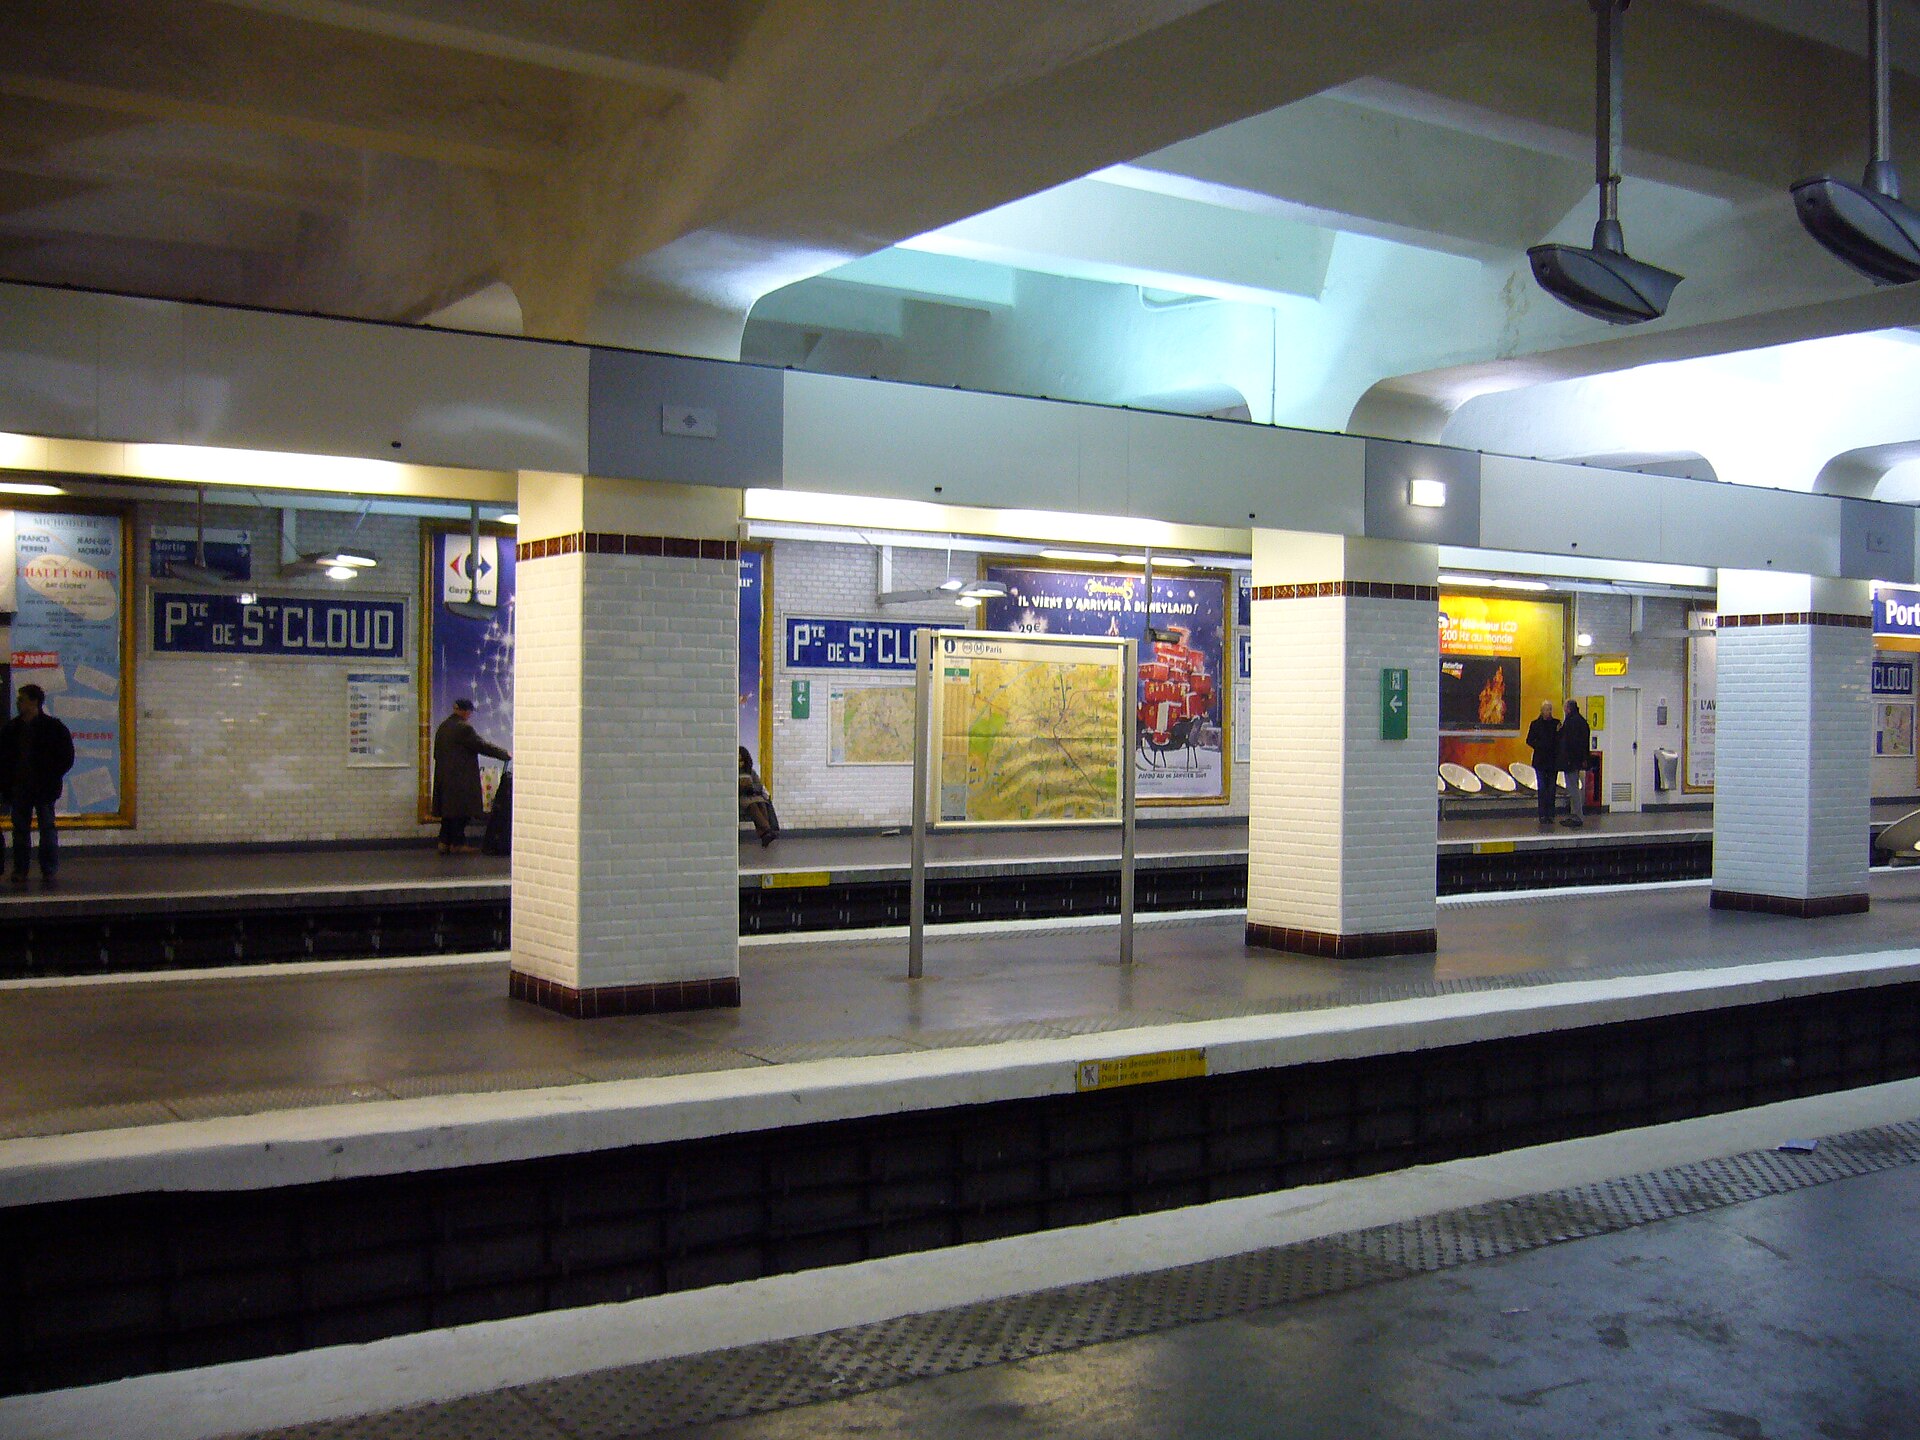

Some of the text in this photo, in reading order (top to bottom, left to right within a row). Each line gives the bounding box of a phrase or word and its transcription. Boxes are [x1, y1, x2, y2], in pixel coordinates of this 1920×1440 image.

[17, 535, 50, 543] FRANCIS
[155, 542, 186, 552] Sortie
[1018, 595, 1029, 607] IL
[1032, 596, 1062, 609] VIENT
[1065, 599, 1121, 612] D'ARRIVER
[1133, 600, 1199, 615] DINEYLAND!
[1885, 599, 1920, 627] Port
[212, 623, 235, 645] DE
[282, 606, 394, 650] CLOUD
[1502, 621, 1518, 632] LCD
[1442, 630, 1514, 644] 200 Hz au monde
[827, 642, 845, 662] DE
[1873, 666, 1910, 691] CLOUD
